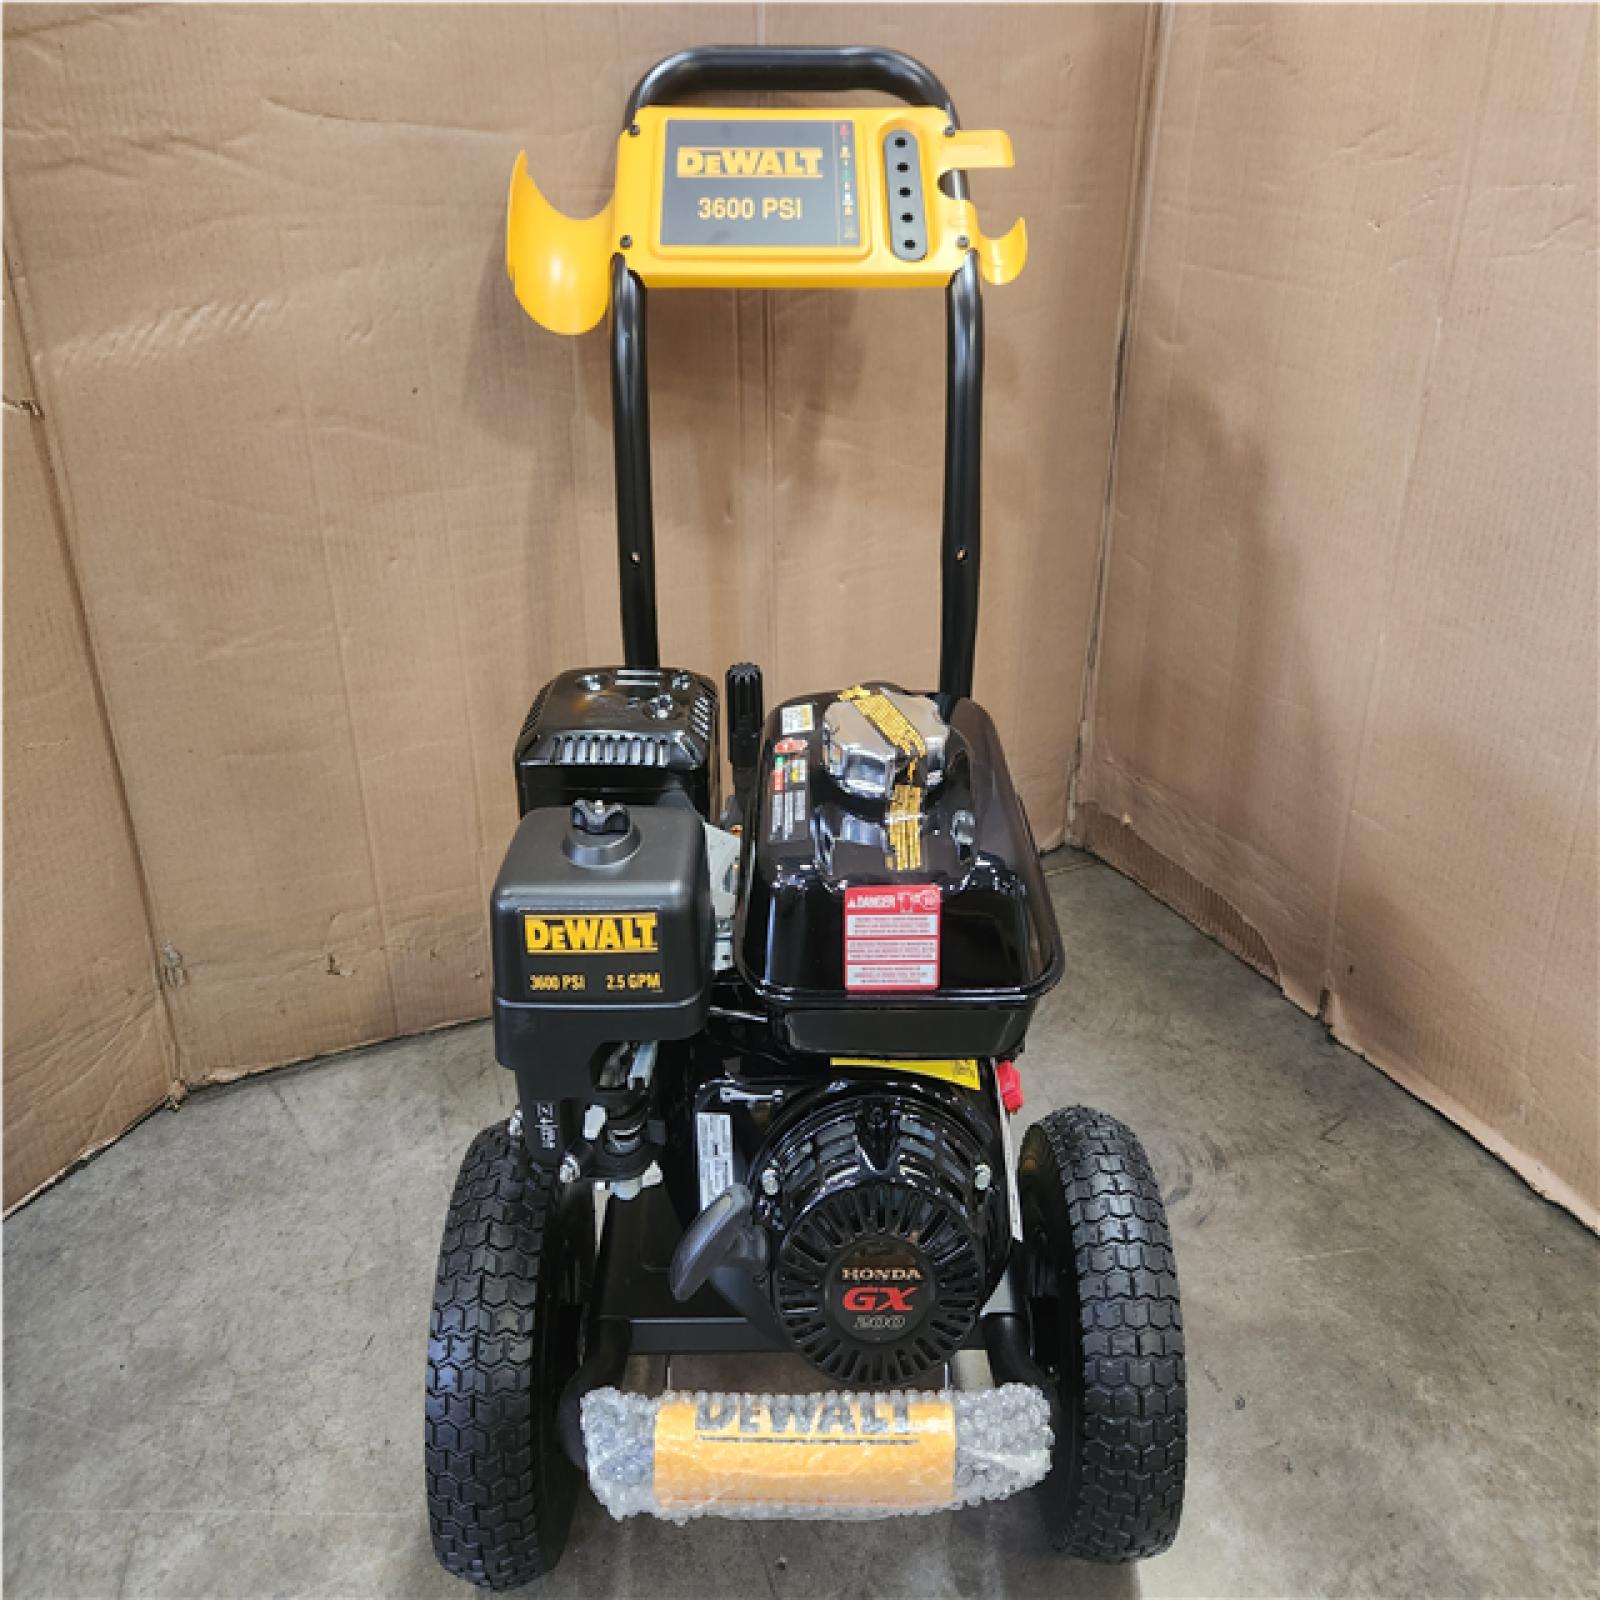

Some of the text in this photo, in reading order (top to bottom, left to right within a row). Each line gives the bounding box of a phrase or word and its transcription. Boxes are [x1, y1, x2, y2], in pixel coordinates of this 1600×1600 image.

[698, 197, 803, 220] 3600 PSI
[606, 974, 625, 990] 2.5
[628, 972, 661, 989] GPM
[841, 1267, 923, 1281] HONDA
[842, 1287, 919, 1311] GX
